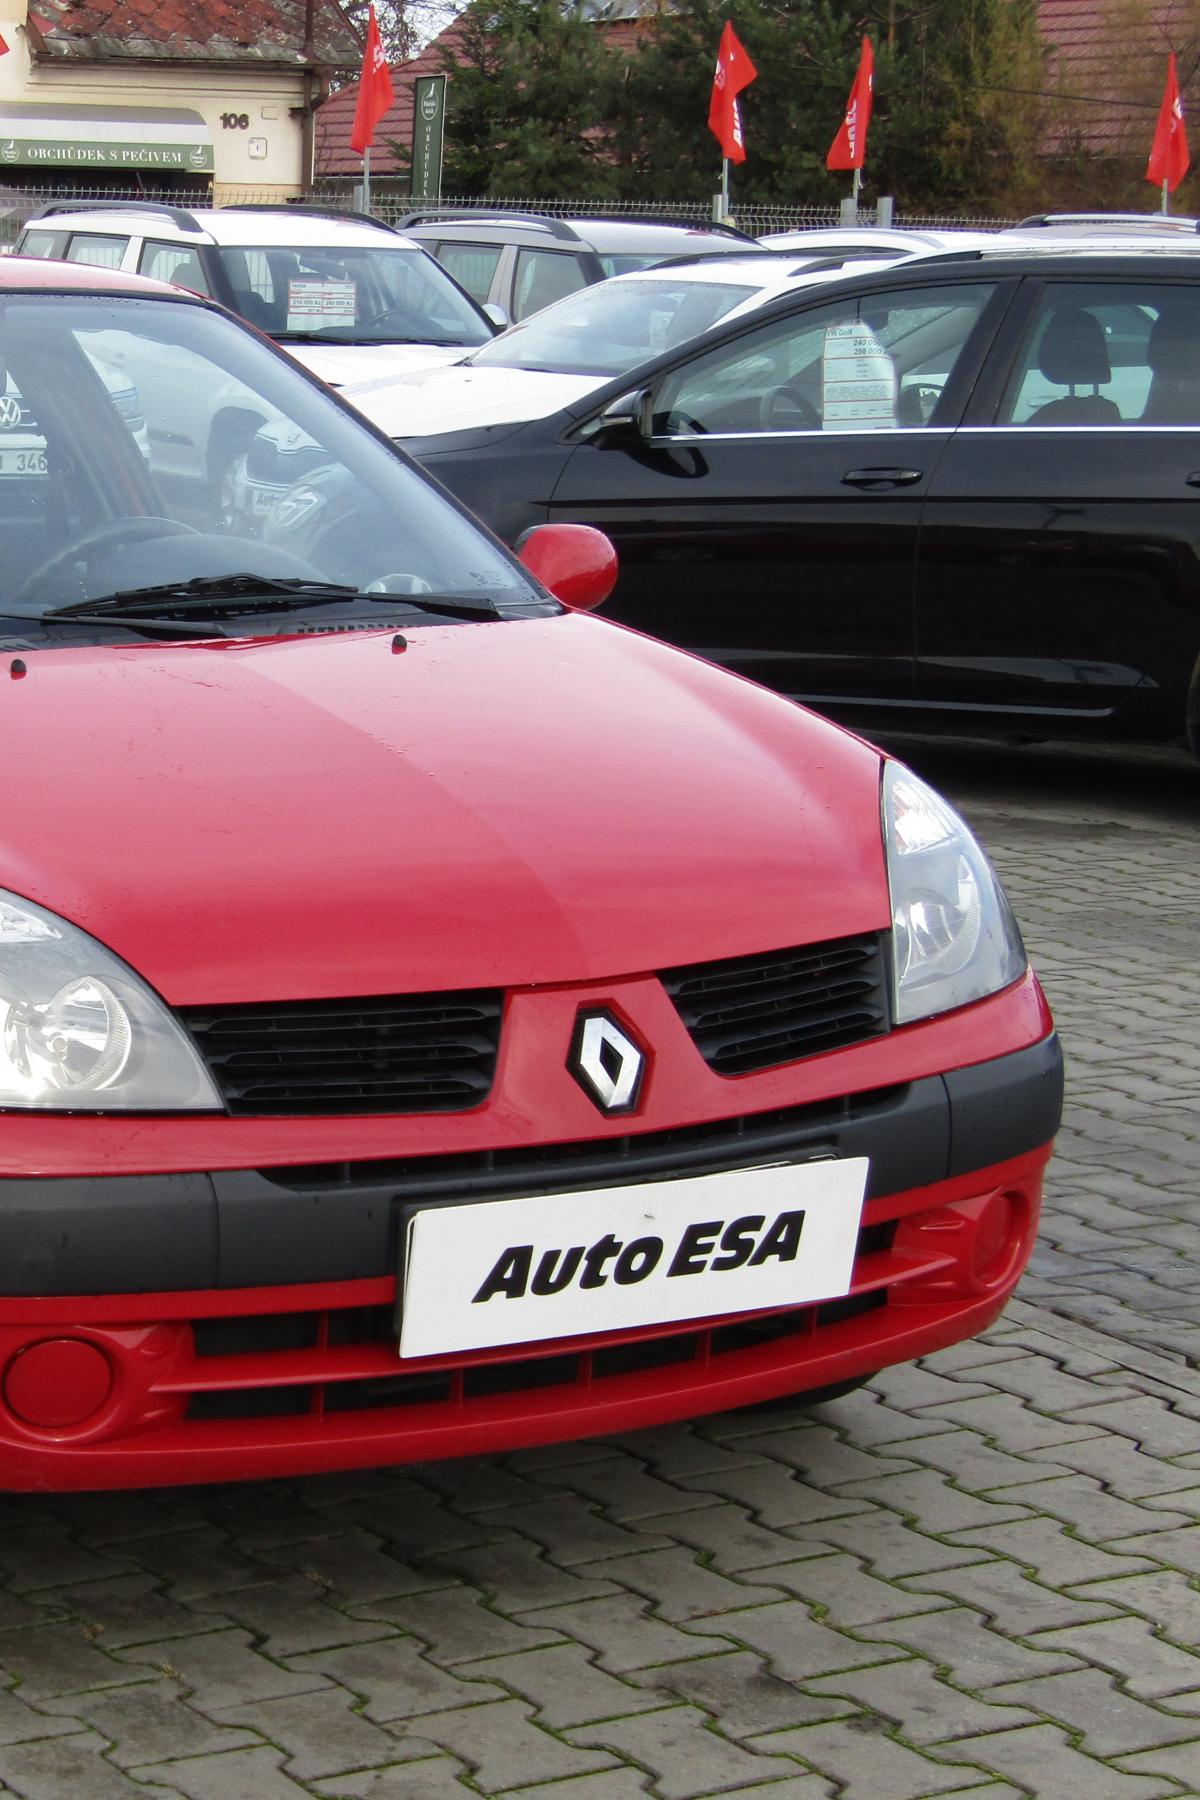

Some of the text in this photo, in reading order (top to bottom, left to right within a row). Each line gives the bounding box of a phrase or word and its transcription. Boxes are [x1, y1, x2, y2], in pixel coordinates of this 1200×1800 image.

[220, 113, 249, 130] 106
[27, 146, 105, 161] OBCHŮDEK
[109, 150, 118, 161] S
[122, 149, 182, 163] PEČIVEM
[471, 1210, 806, 1304] Auto ESA
